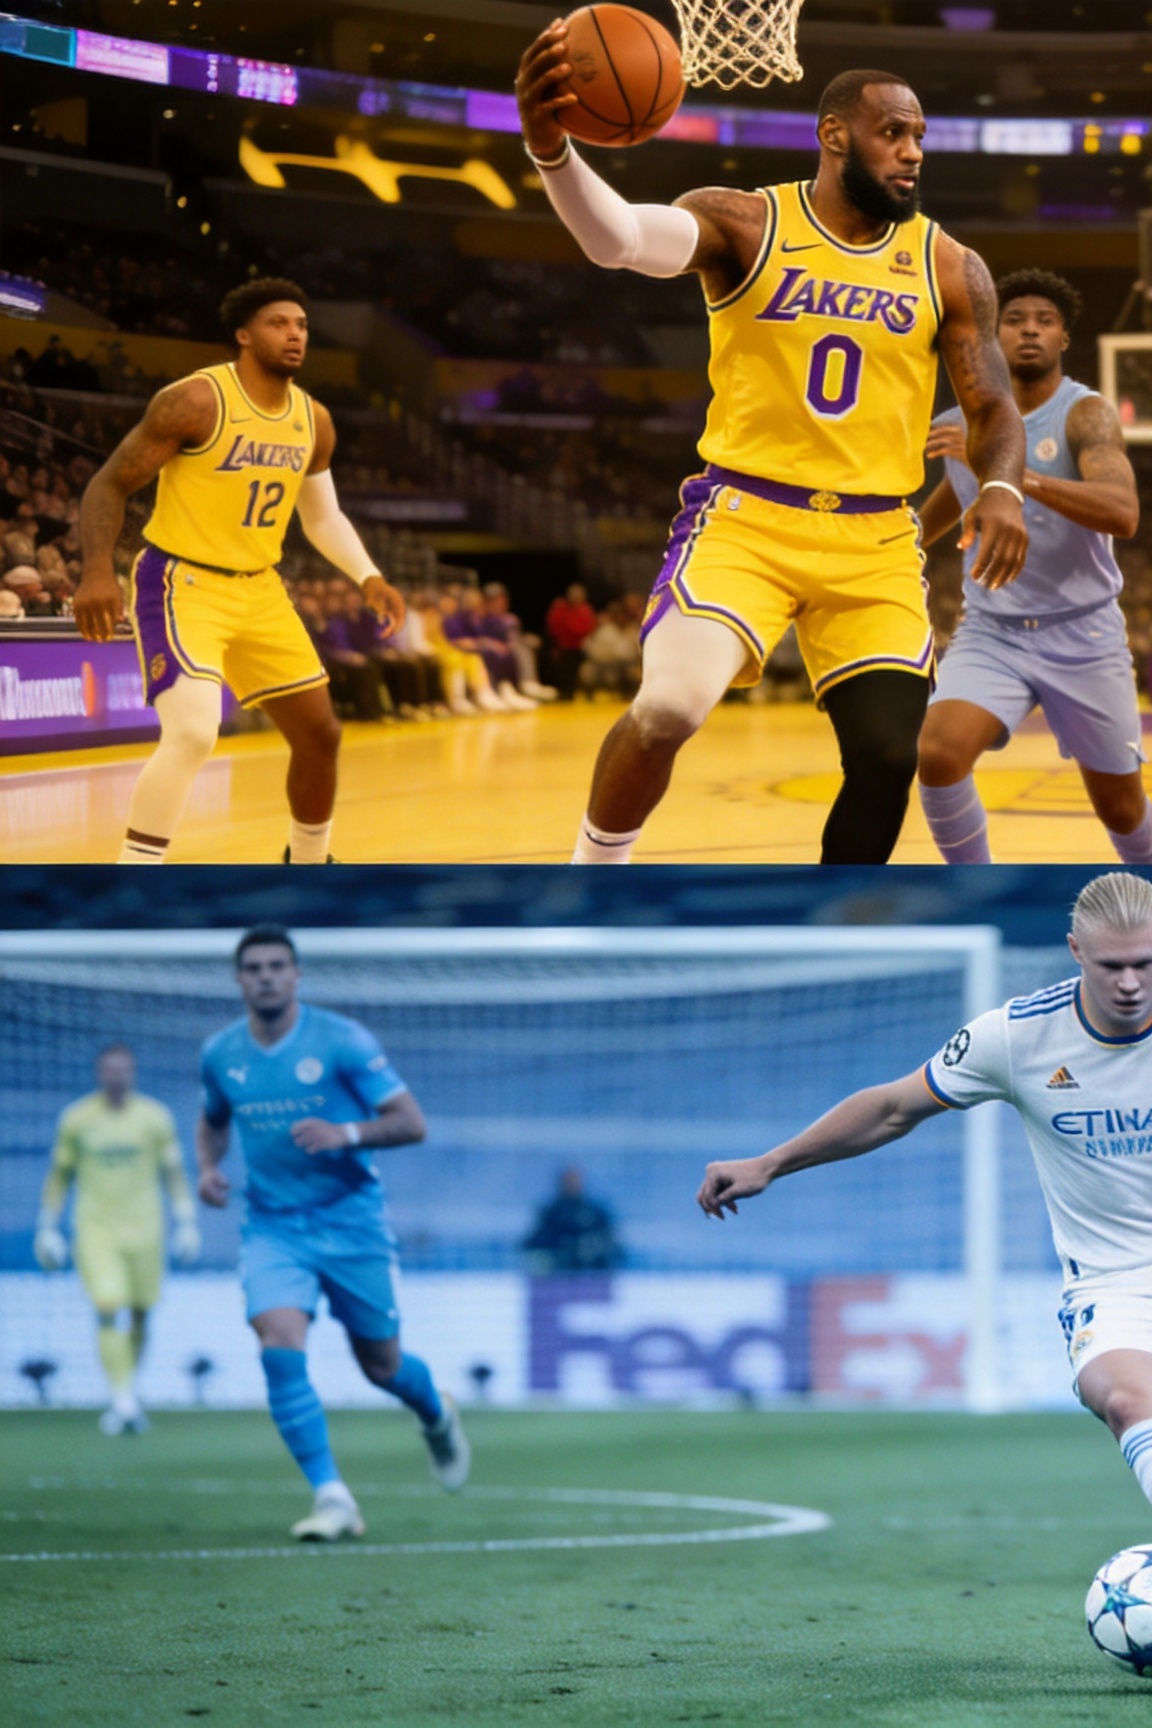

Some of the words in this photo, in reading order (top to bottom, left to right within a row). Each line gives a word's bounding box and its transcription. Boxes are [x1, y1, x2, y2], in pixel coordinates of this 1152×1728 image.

[754, 266, 919, 335] LAKERS
[805, 332, 864, 421] 0
[241, 480, 286, 528] 12
[528, 1273, 968, 1395] FedEx
